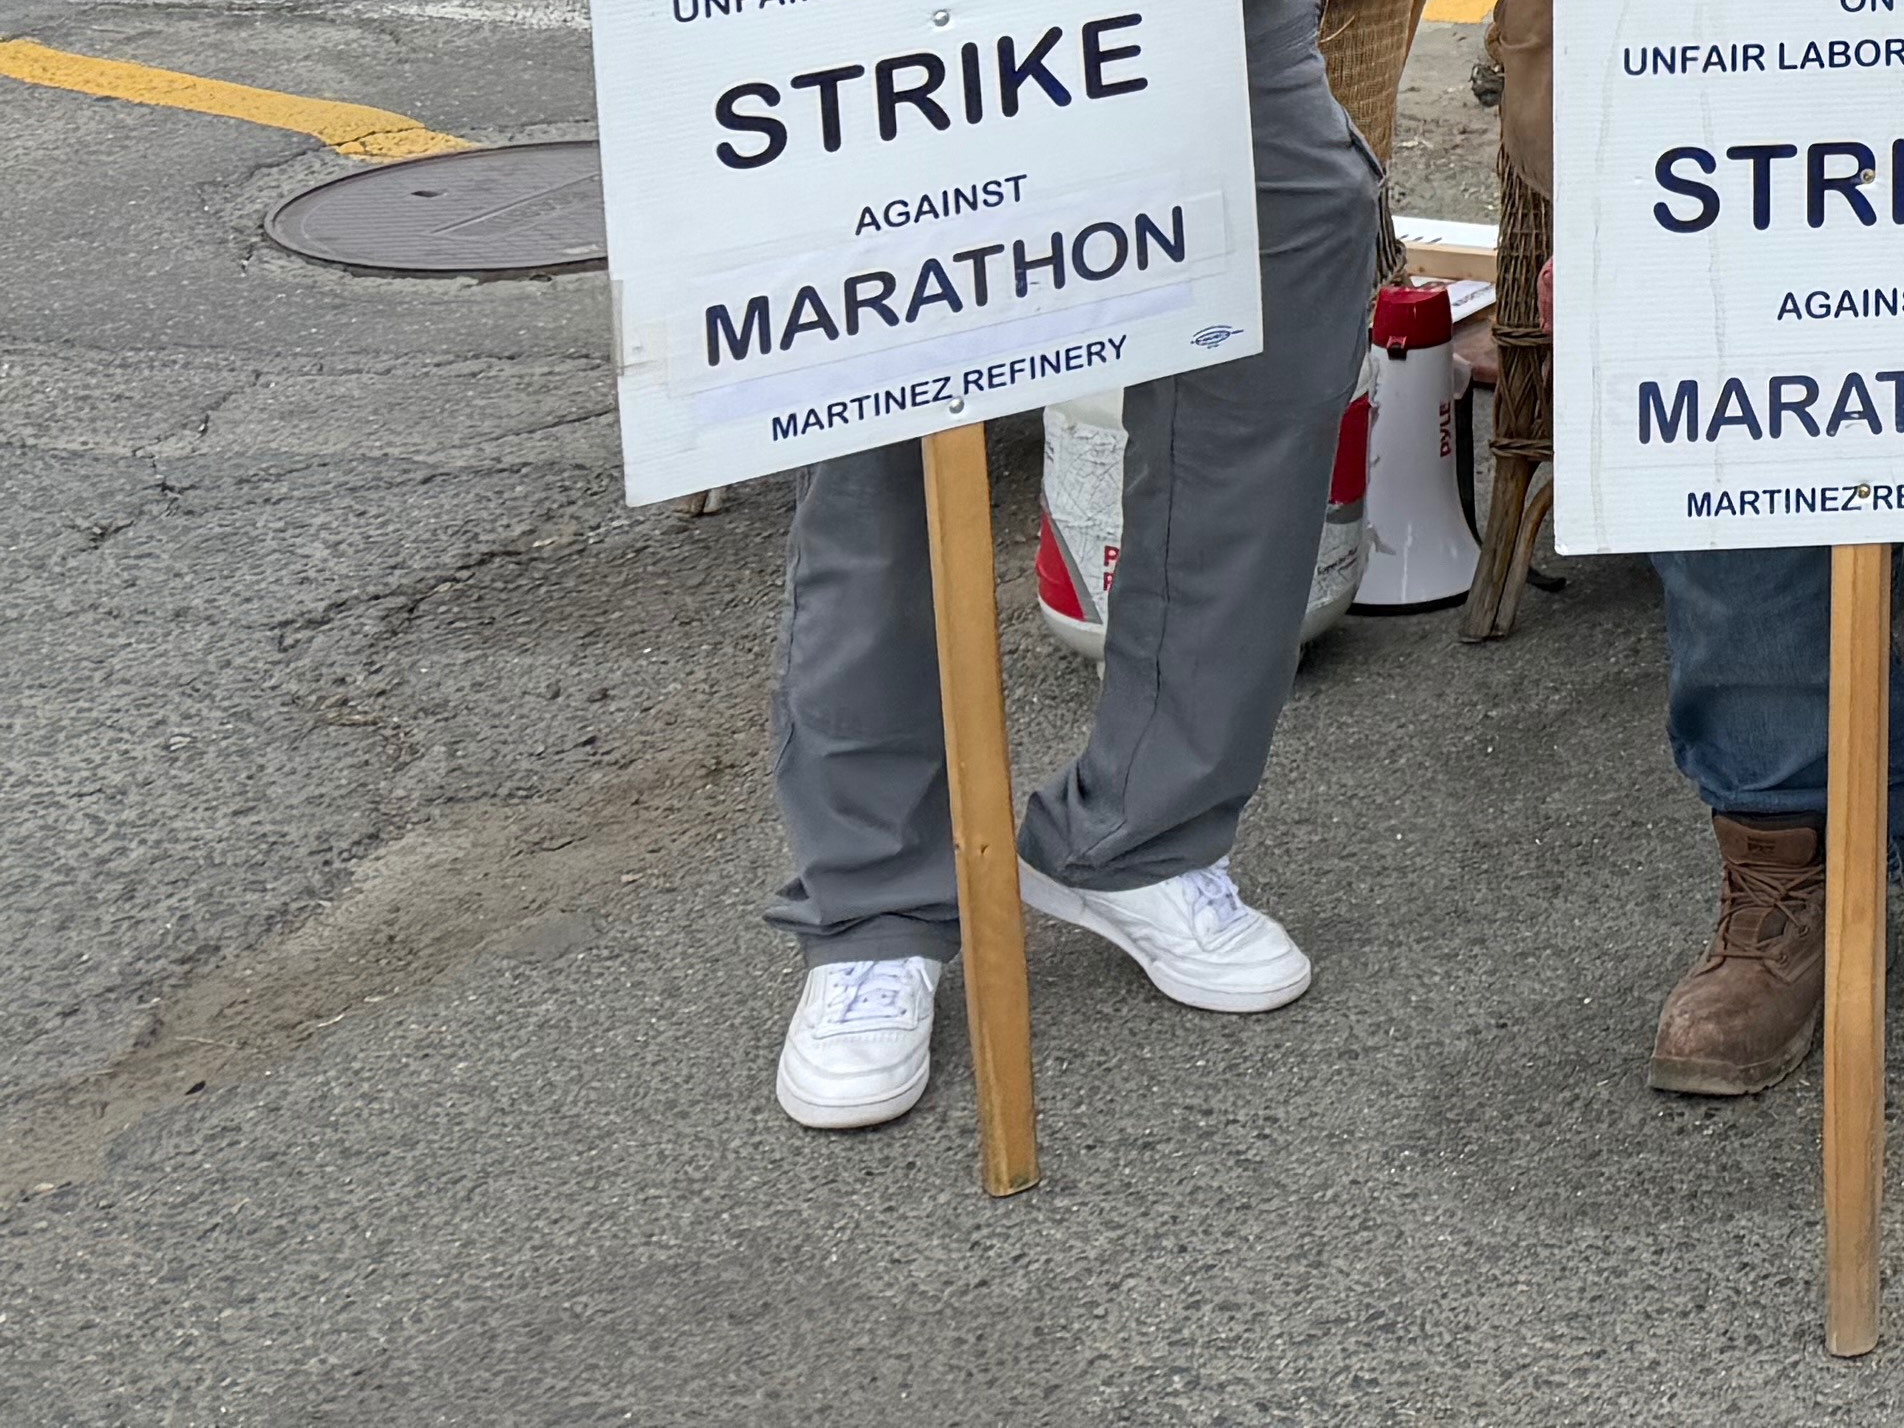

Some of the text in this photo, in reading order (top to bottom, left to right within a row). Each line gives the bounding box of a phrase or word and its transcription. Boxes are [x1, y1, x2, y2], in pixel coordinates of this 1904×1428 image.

[715, 13, 1148, 169] STRIKE
[1624, 44, 1765, 75] UNFAIR
[855, 174, 1027, 236] AGAINST
[706, 206, 1187, 368] MARATHON
[771, 335, 1126, 442] MARTINEZ REFINERY
[1686, 485, 1861, 518] MARTINEZ
